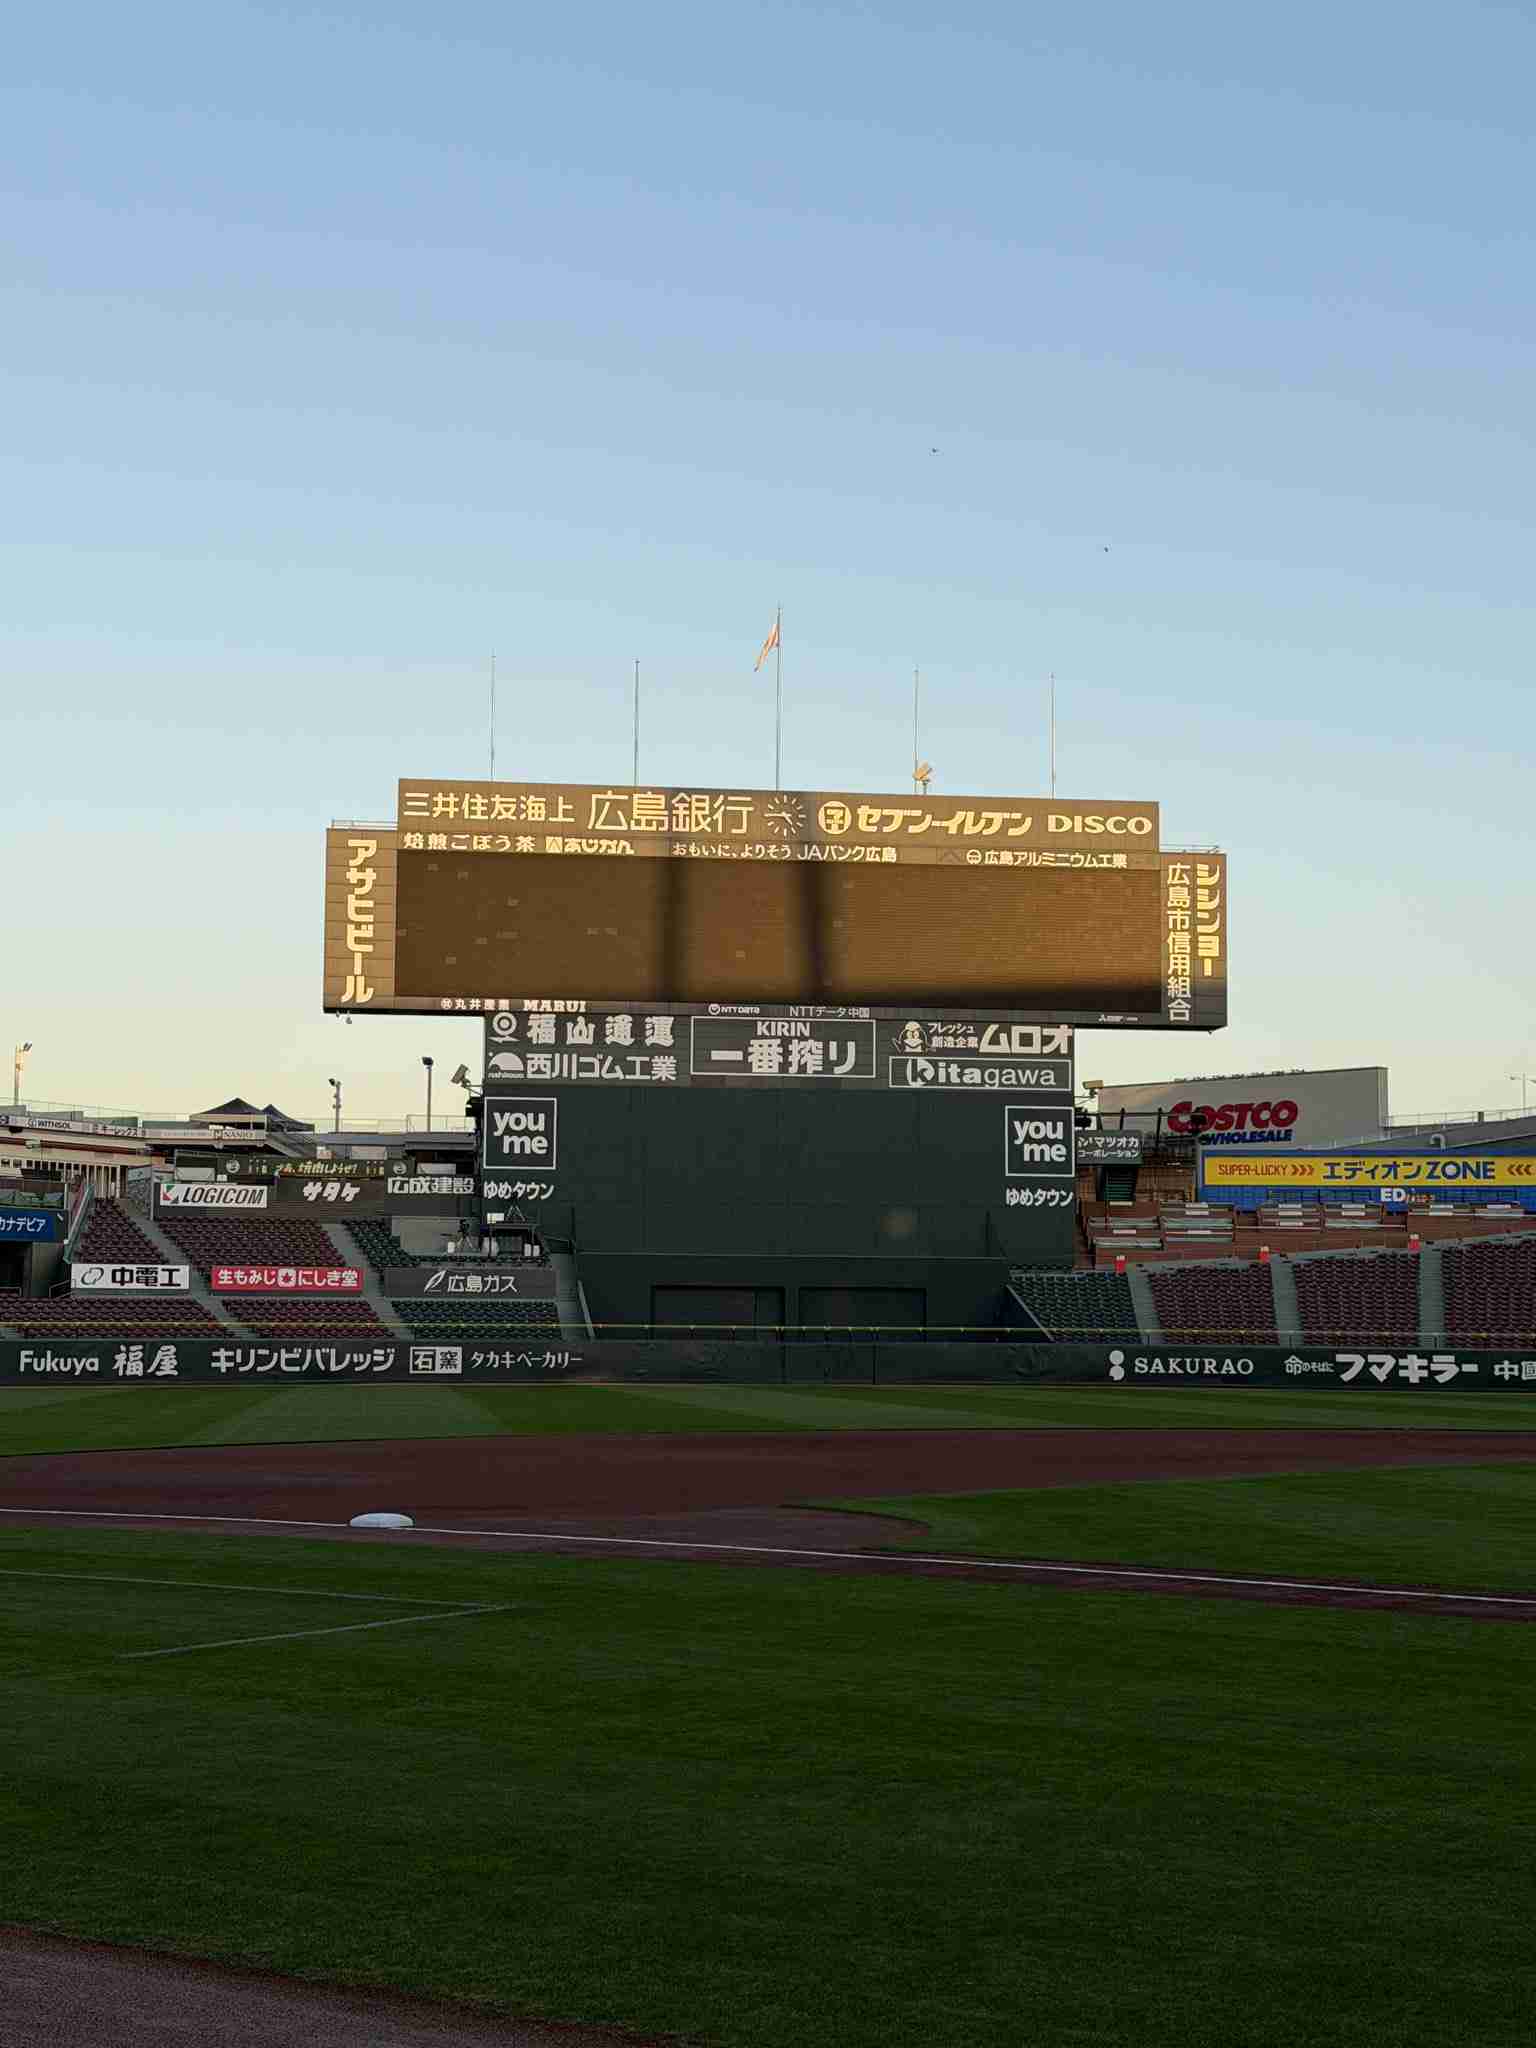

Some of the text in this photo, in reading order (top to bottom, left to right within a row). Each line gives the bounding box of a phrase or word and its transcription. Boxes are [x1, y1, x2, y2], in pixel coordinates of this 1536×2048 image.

[403, 792, 575, 823] 三井住友海上
[587, 790, 754, 834] 広島銀行
[1047, 815, 1153, 835] DISCO
[796, 843, 897, 863] JAバンク広島
[984, 850, 1127, 870] 広島アルミニウム工業
[341, 839, 377, 1003] アサヒビール
[1196, 864, 1220, 976] シシンヨー
[1167, 863, 1191, 1021] 広島市信用組合
[523, 999, 586, 1012] MARUI
[756, 1021, 810, 1037] KIRIN
[928, 1022, 975, 1034] フレッシュ
[979, 1024, 1073, 1054] ムロオ
[525, 1053, 677, 1081] 西川ゴム工業
[711, 1038, 856, 1075] 一番搾り
[493, 1111, 545, 1136] you
[1167, 1100, 1298, 1133] COSTCO
[1013, 1120, 1064, 1144] you
[503, 1134, 548, 1154] me
[1023, 1142, 1067, 1162] me
[182, 1186, 265, 1206] LOGICOM
[302, 1181, 361, 1202] サタケ
[483, 1181, 554, 1200] ゆめタウン
[1006, 1188, 1074, 1207] ゆめタウン
[111, 1266, 181, 1287] 中電工
[218, 1269, 358, 1287] 生もみじ にしき堂
[447, 1275, 518, 1293] 広島ガス
[20, 1350, 100, 1376] Fukuya
[112, 1344, 179, 1377] 福屋
[211, 1347, 395, 1373] キリンビバレッジ
[470, 1351, 583, 1369] タカキベーカリー
[1135, 1357, 1254, 1374] SAKURAO
[1335, 1354, 1479, 1384] フマキラー
